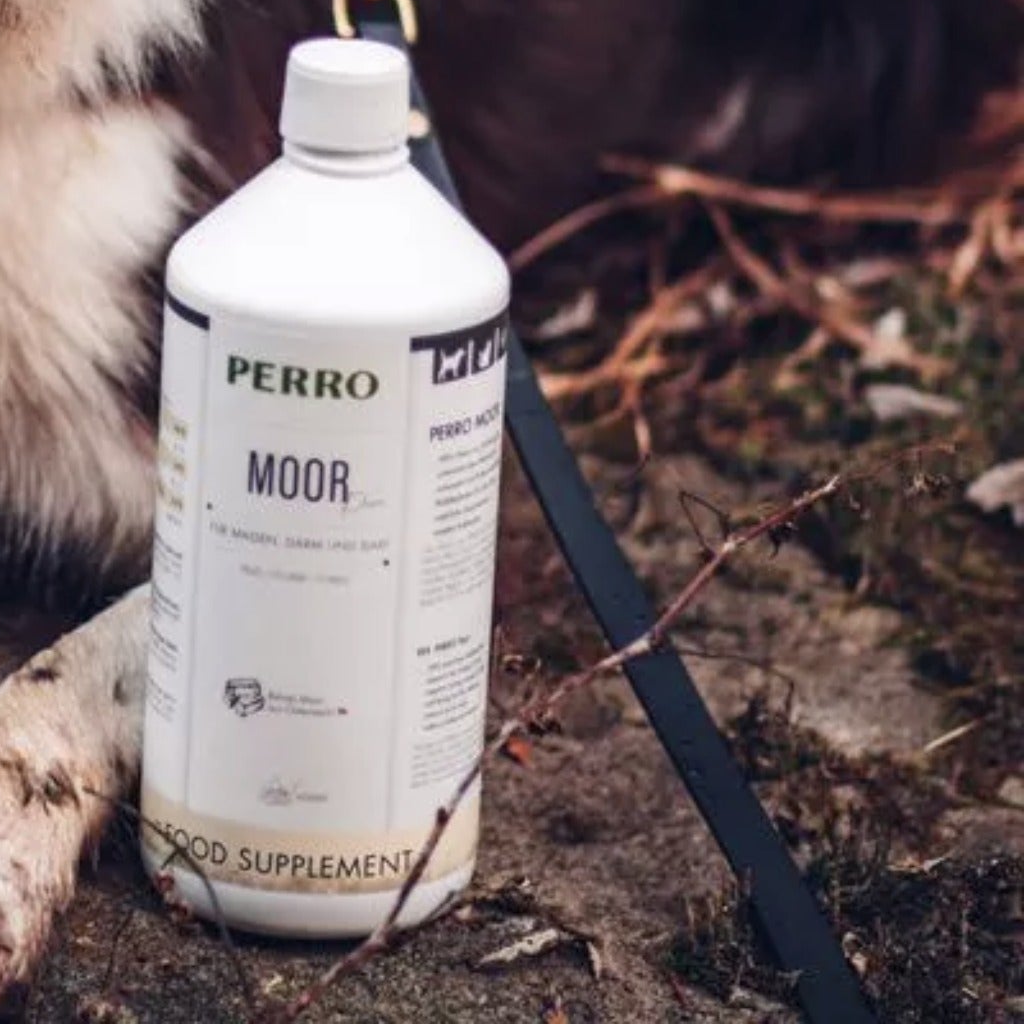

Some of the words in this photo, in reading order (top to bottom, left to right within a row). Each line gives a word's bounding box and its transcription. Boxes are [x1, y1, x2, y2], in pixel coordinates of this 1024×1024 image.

[226, 354, 380, 401] PERRO
[429, 417, 473, 443] PERRO
[247, 449, 350, 504] MOOR
[238, 847, 414, 879] SUPPLEMENT
